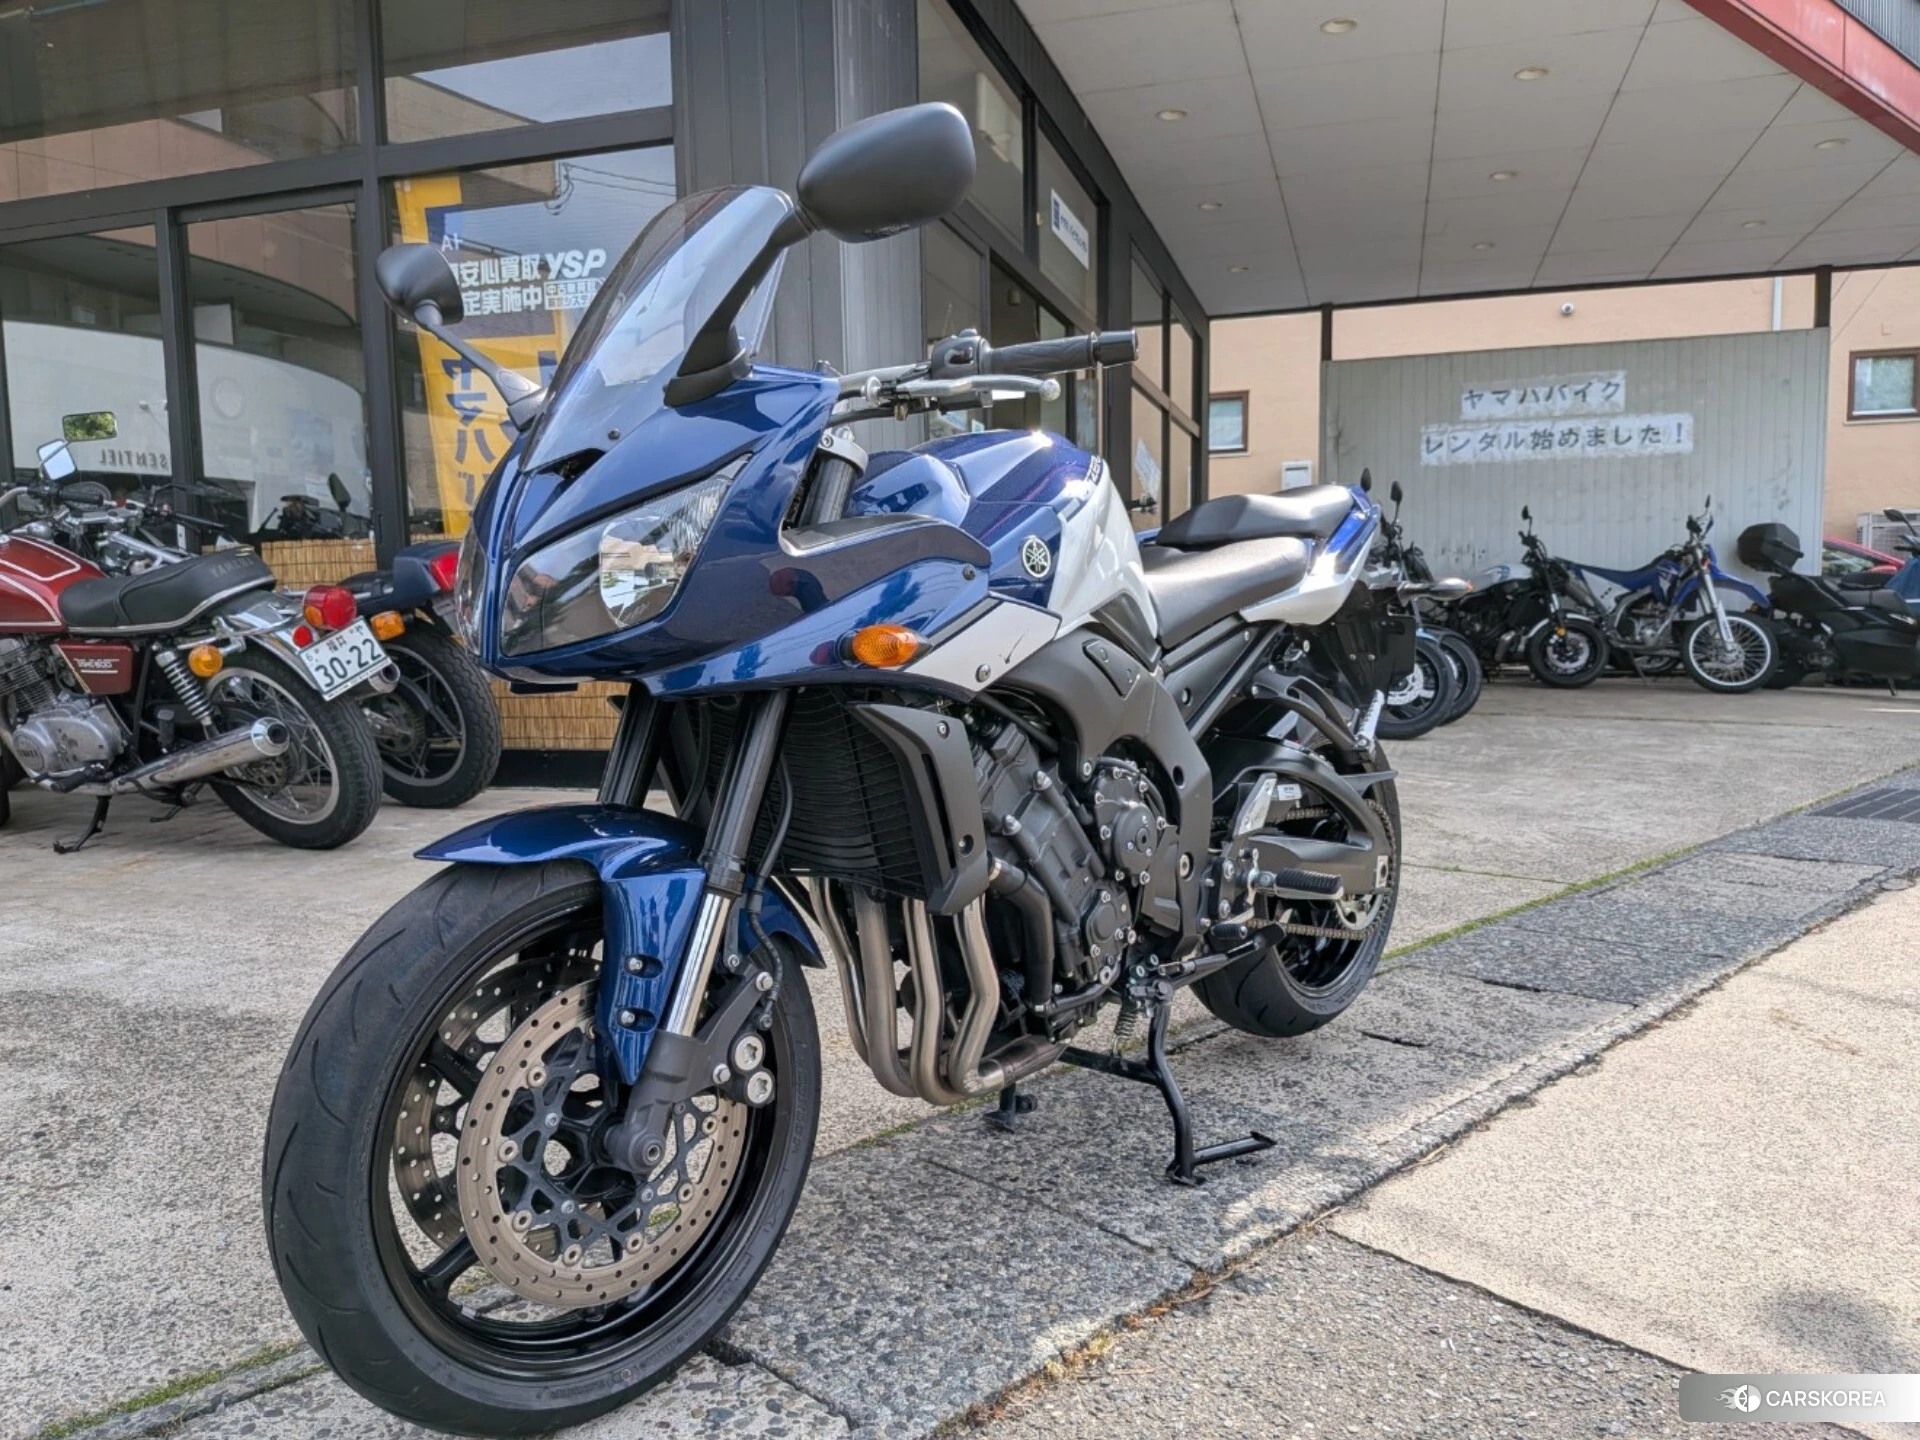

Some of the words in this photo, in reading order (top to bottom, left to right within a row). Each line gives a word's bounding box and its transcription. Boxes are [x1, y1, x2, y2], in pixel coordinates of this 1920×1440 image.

[545, 249, 607, 280] YSP
[1463, 380, 1622, 411] ヤマハバイク
[1424, 422, 1684, 454] レンタル始めました！
